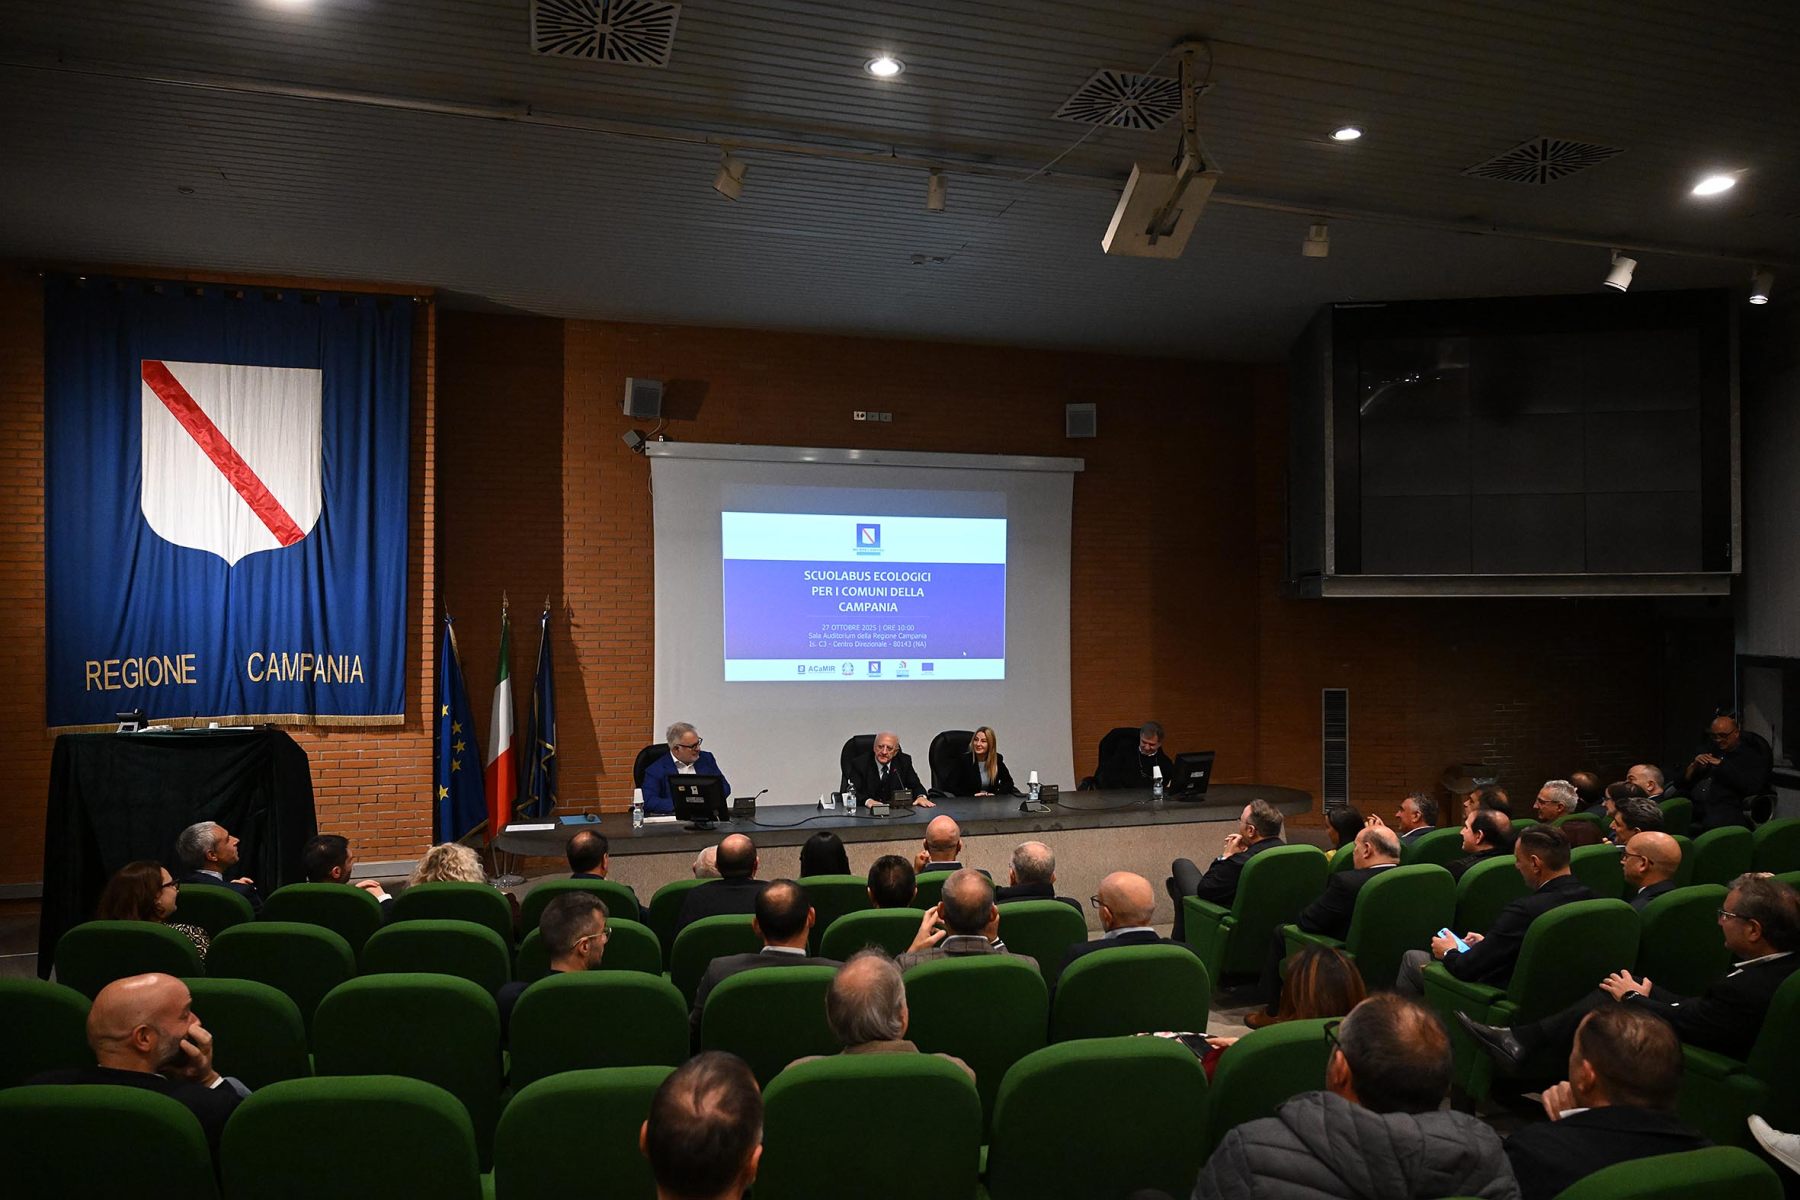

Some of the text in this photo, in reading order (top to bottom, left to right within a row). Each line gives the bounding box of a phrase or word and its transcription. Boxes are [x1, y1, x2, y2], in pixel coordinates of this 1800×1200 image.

[804, 571, 931, 582] SCUOLABUS ECOLOGICI
[812, 586, 924, 597] PER I COMUNI DELLA
[838, 602, 898, 612] CAMPANIA
[86, 652, 364, 691] REGIONE CAMPANIA
